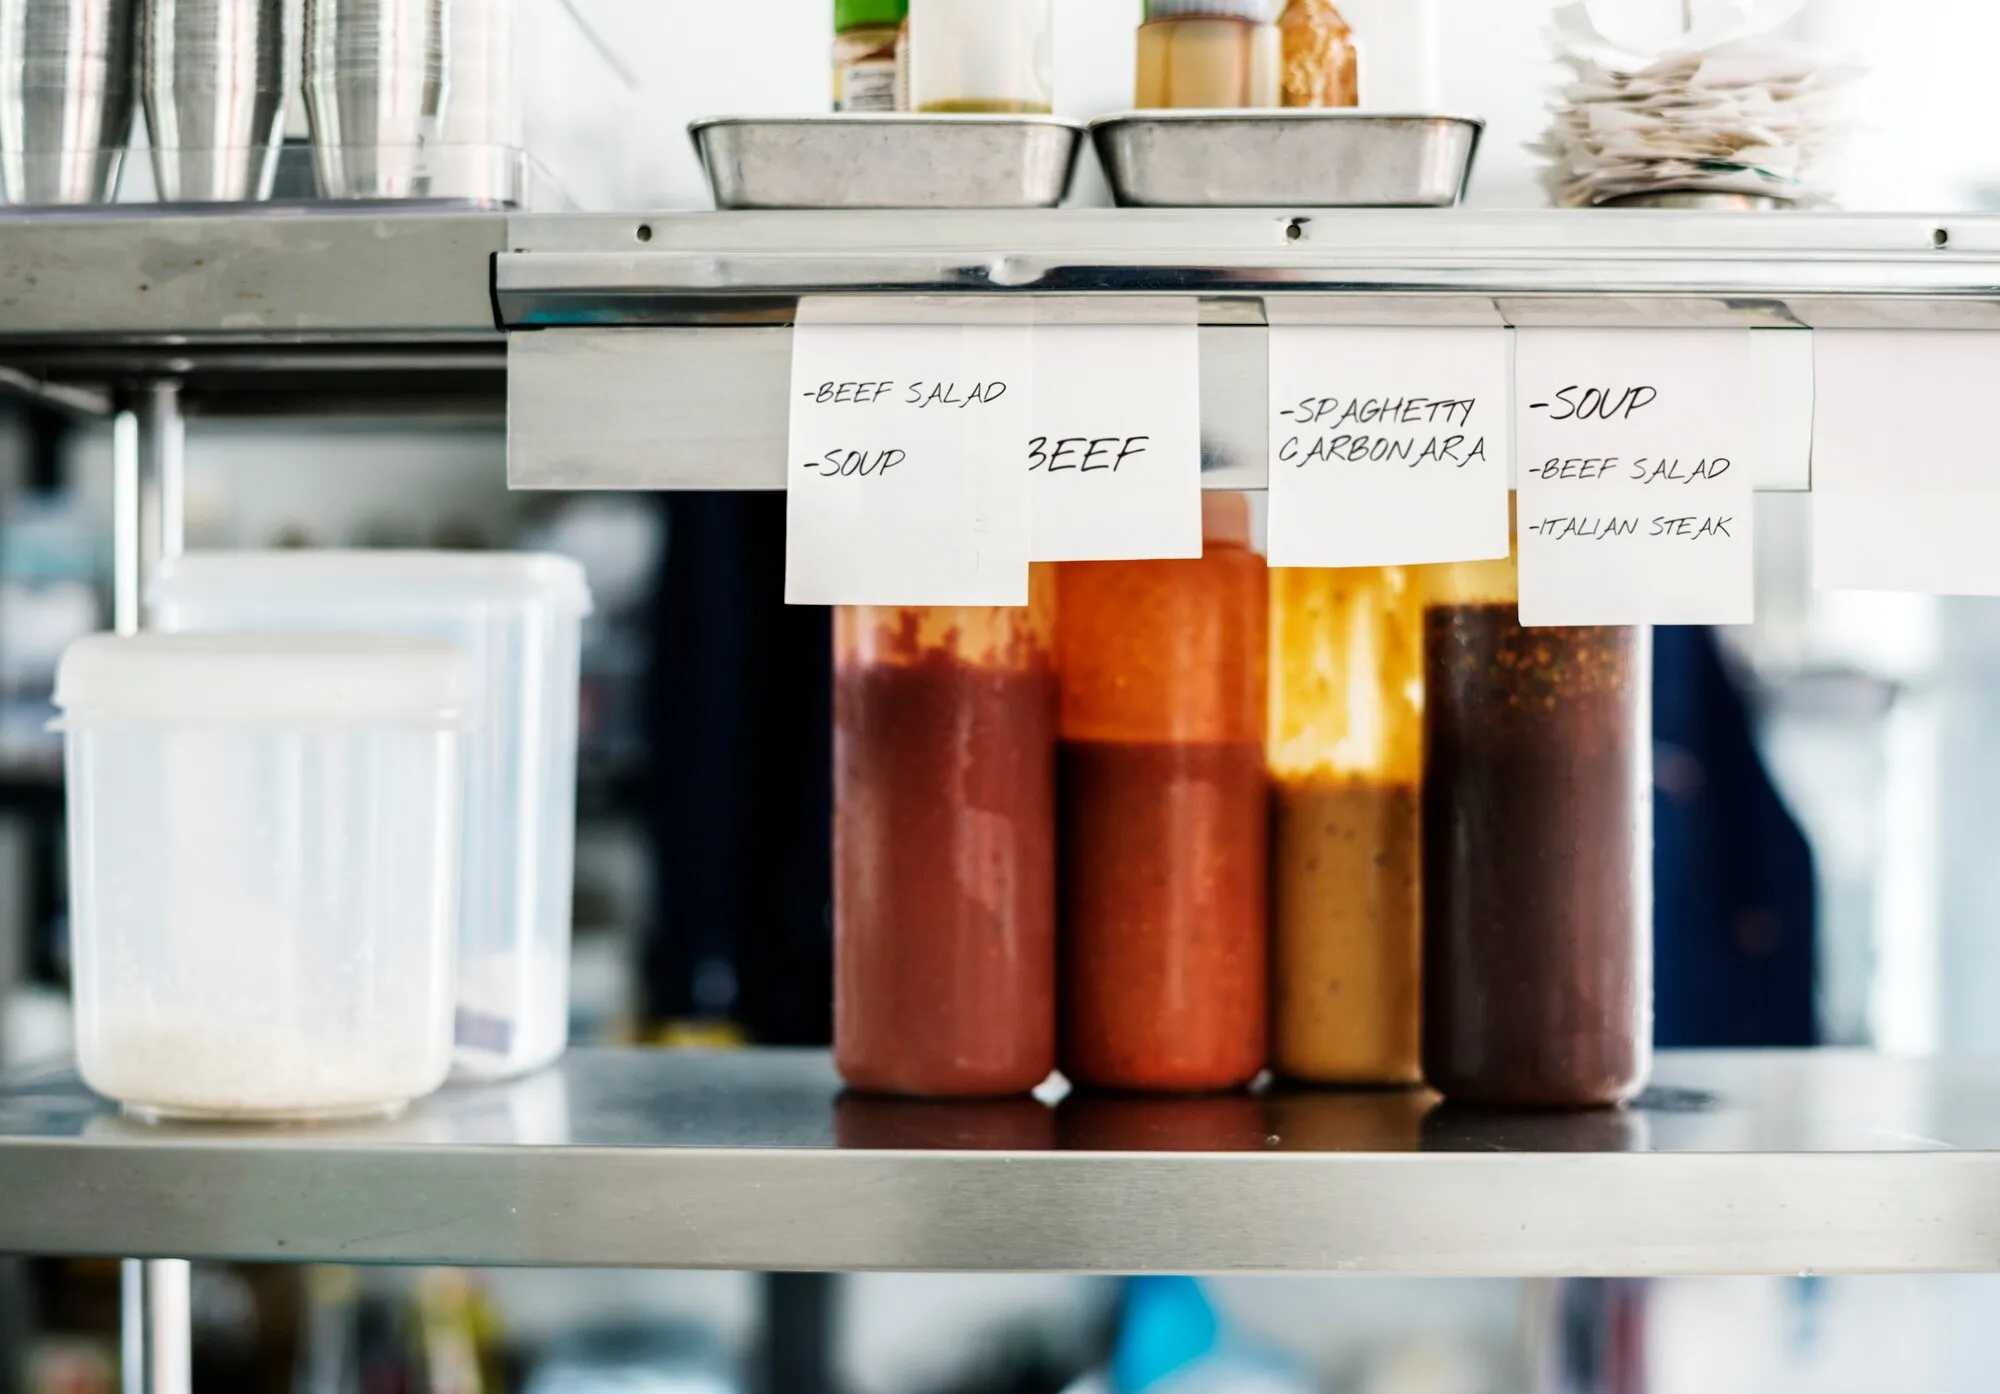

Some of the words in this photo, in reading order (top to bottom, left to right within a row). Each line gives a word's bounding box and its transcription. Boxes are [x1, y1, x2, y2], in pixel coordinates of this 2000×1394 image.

[803, 380, 894, 404] -BEEF
[905, 381, 1007, 409] SALAD
[1528, 385, 1657, 421] -SOUP
[1279, 397, 1476, 430] -SPAGHETTY
[803, 448, 906, 477] -SOUP
[1278, 434, 1486, 468] CARBONARA
[1528, 457, 1620, 480] -BEEF
[1630, 457, 1731, 485] SALAD
[1528, 516, 1639, 541] -ITALIAN
[1648, 516, 1733, 541] STEAK
